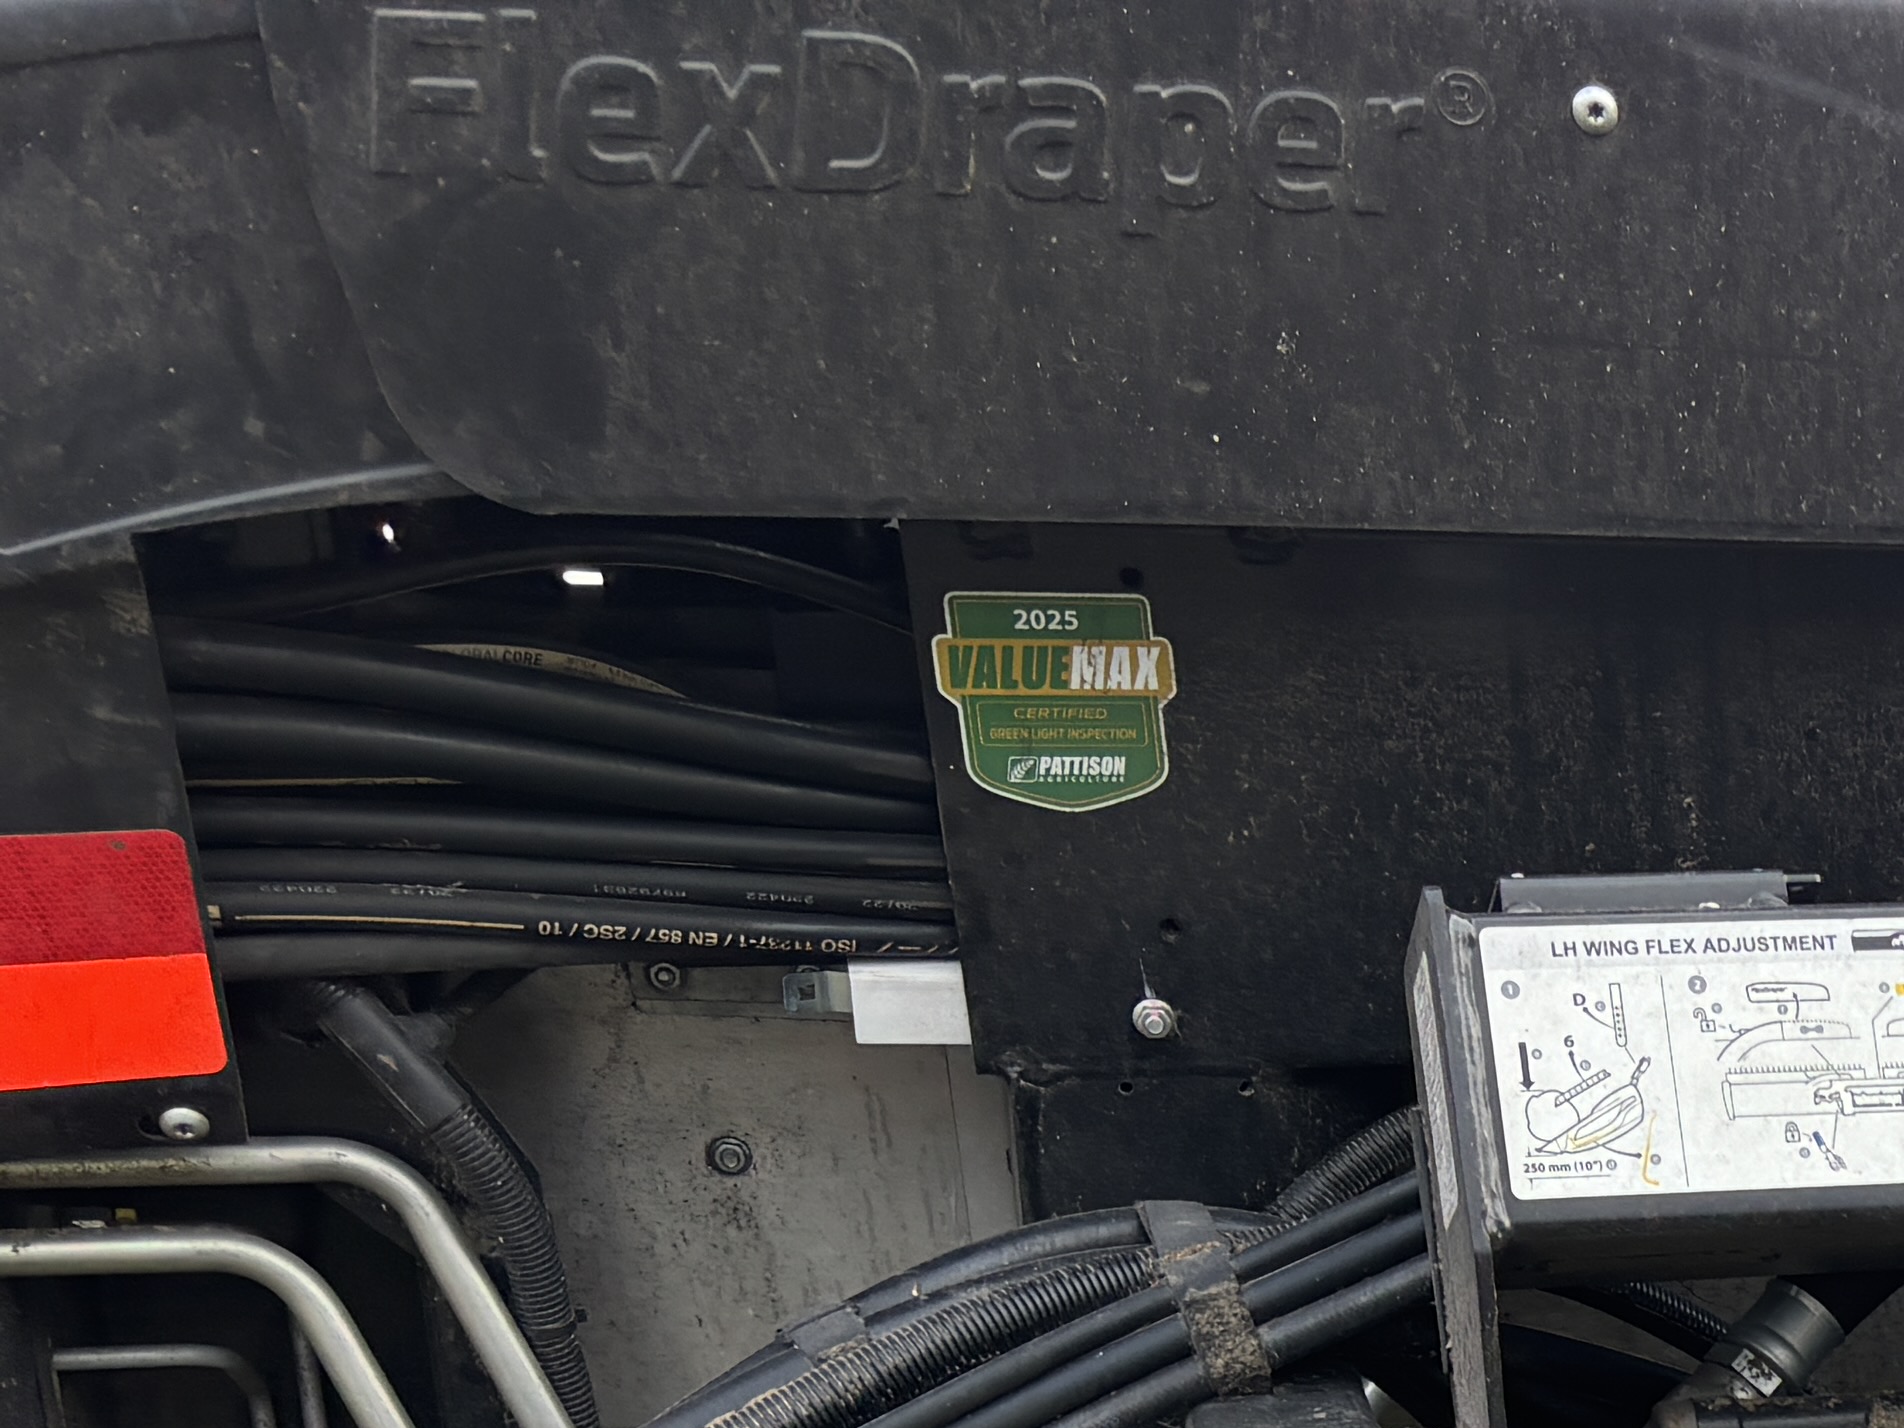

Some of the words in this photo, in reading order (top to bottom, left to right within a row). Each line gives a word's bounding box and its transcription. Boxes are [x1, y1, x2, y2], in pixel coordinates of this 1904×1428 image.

[1013, 609, 1079, 630] 2025
[947, 644, 1161, 691] VALUEMAX
[1014, 707, 1108, 720] CERTIFIED
[989, 727, 1028, 741] GREEN
[1031, 727, 1063, 740] LIGHT
[1066, 727, 1137, 740] INSPECTION
[1039, 756, 1127, 777] PATTISON
[1039, 775, 1125, 783] AGRICULTURE
[538, 920, 562, 936] 10
[584, 923, 625, 940] 2SC
[644, 926, 681, 944] 857
[688, 929, 718, 945] EN
[821, 938, 856, 953] ISO
[1551, 939, 1578, 958] LH
[1583, 938, 1639, 957] WING
[1646, 936, 1697, 956] FLEX
[1702, 934, 1838, 955] ADJUSTMENT
[1573, 993, 1586, 1006] D
[1564, 1036, 1574, 1048] 6
[1523, 1163, 1545, 1173] 250
[1549, 1163, 1571, 1172] mm
